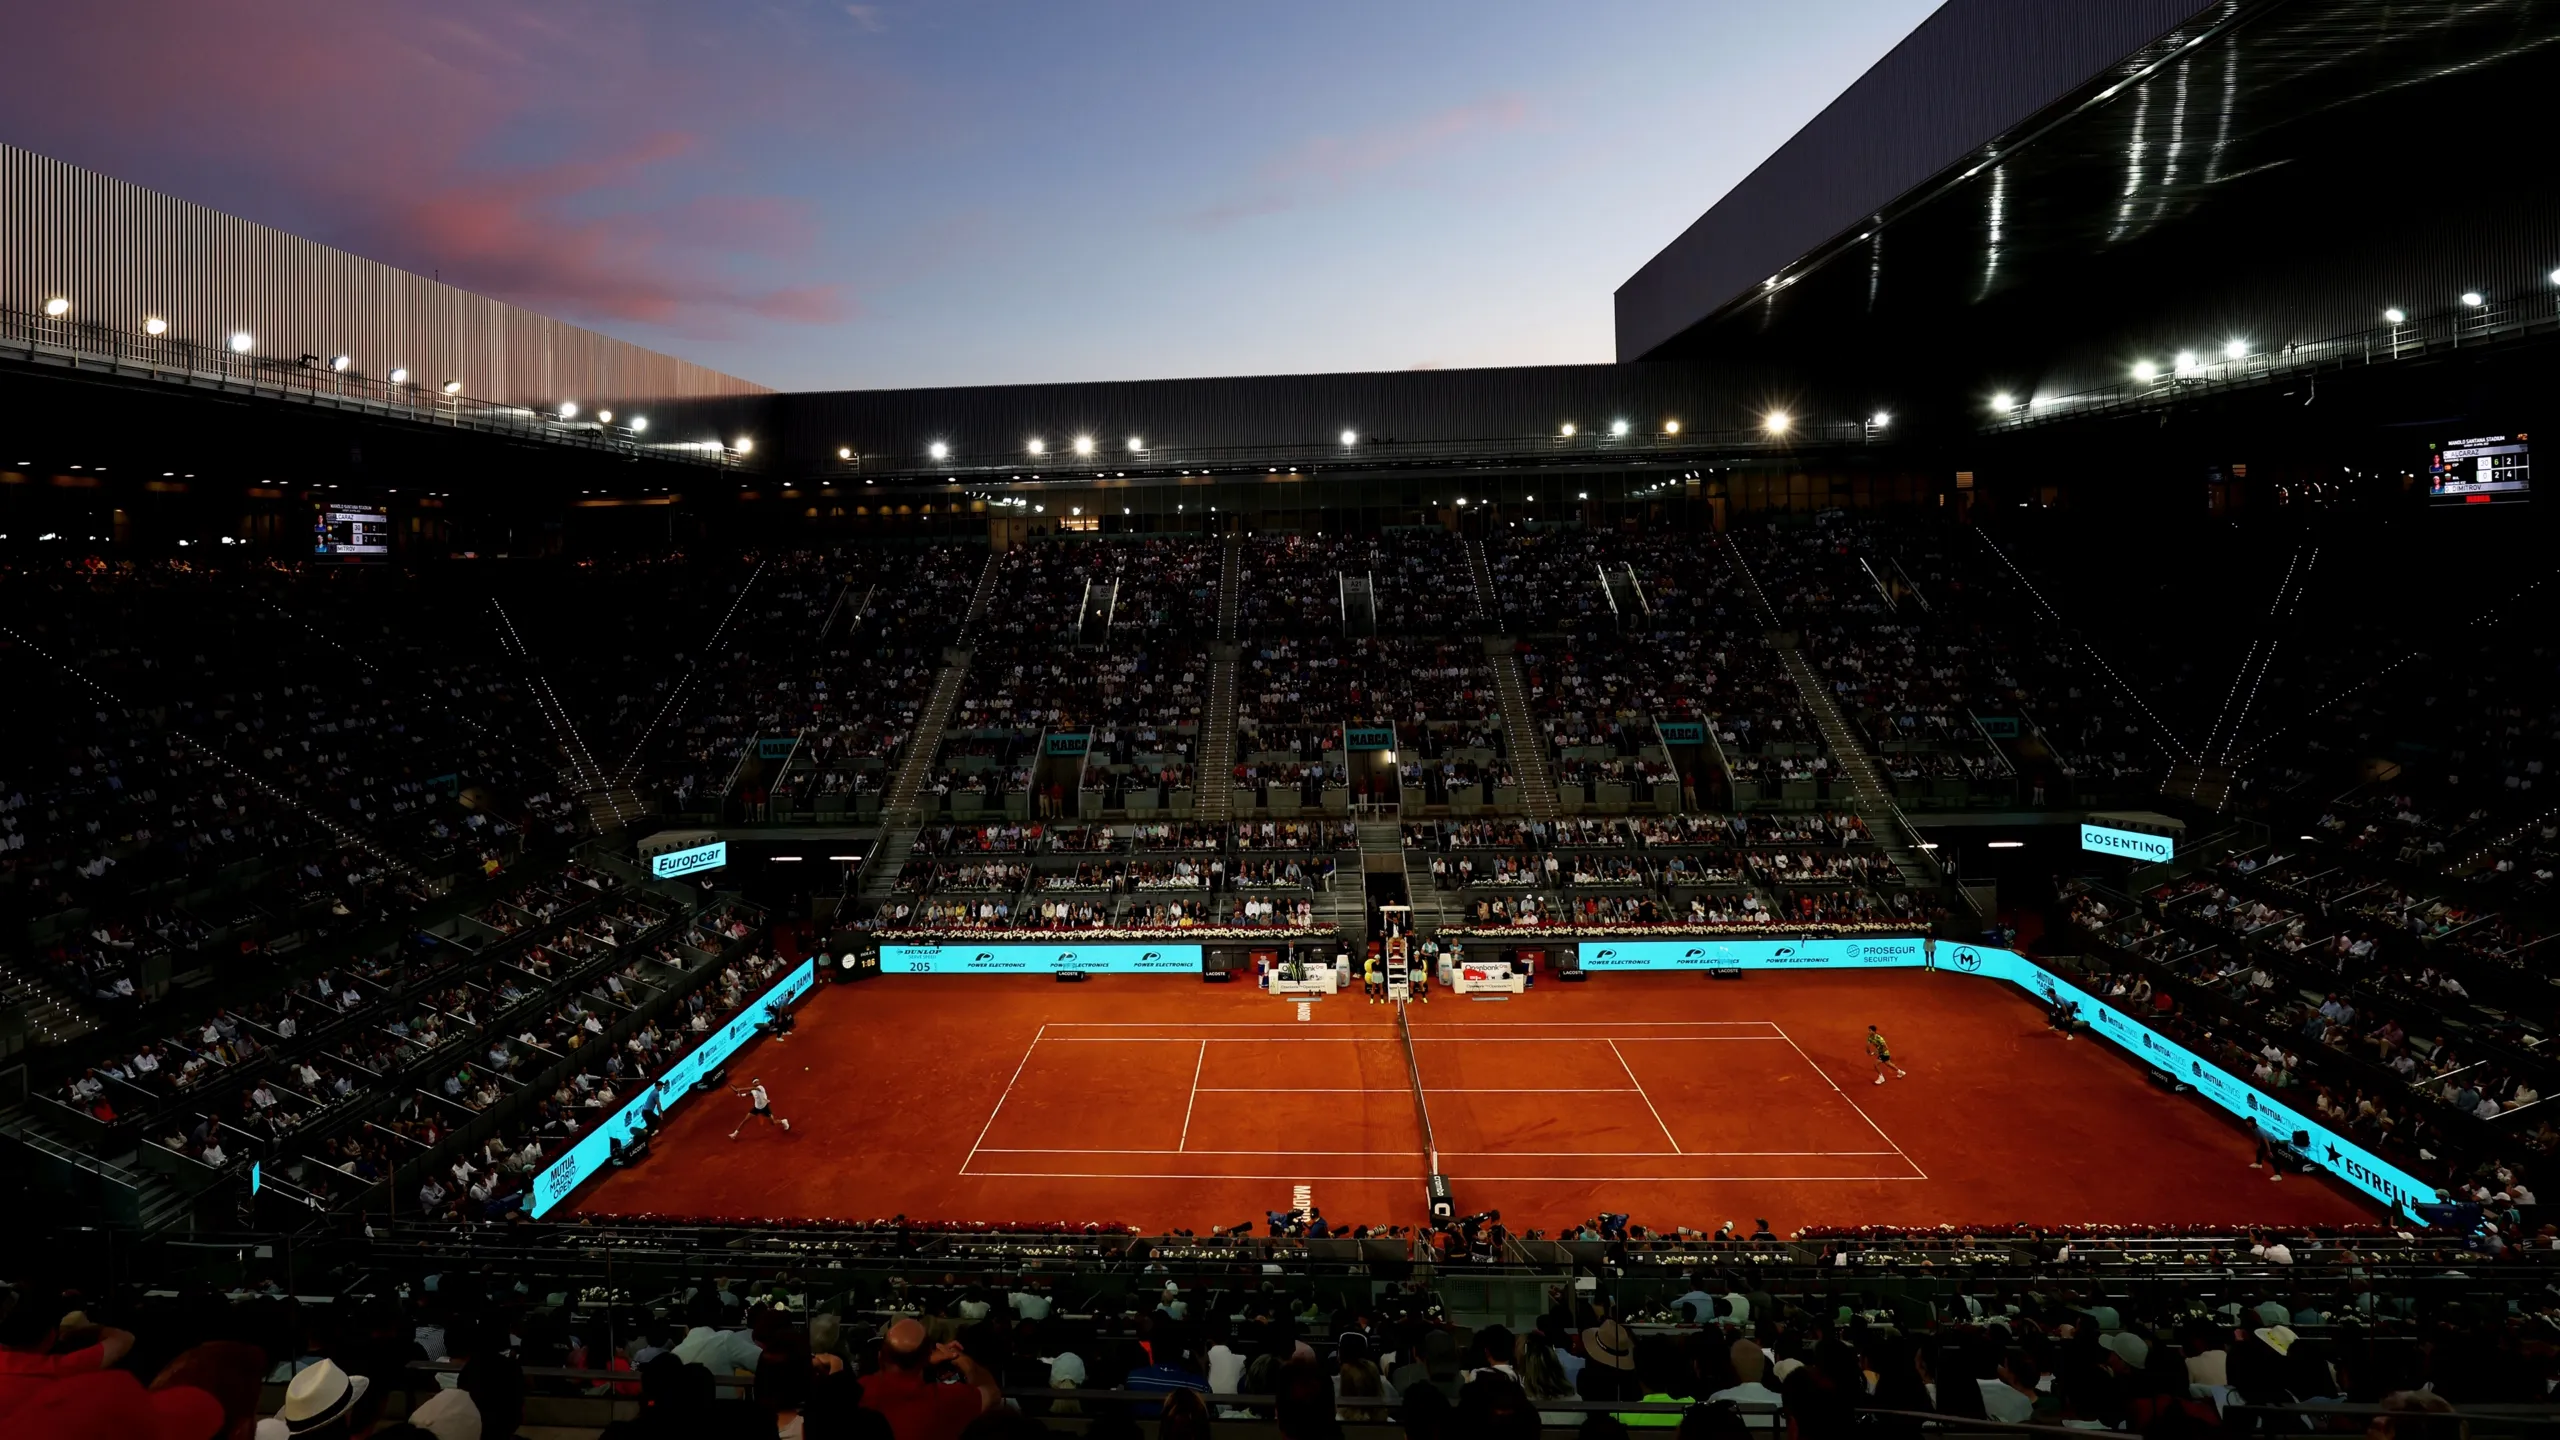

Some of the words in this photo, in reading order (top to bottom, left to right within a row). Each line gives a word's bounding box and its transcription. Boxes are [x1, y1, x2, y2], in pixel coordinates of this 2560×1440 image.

[1350, 734, 1389, 745] MARCA
[1662, 728, 1699, 740] MARCA
[763, 744, 794, 754] MARC
[2085, 833, 2166, 855] COSENTINO
[659, 849, 721, 871] Europcar
[910, 963, 930, 971] 205
[2152, 1069, 2168, 1083] LACOSTE
[630, 1142, 646, 1157] LACOSTE
[550, 1155, 574, 1182] MUTUA
[549, 1166, 576, 1193] MADRID
[1434, 1176, 1444, 1197] crombo
[554, 1179, 573, 1199] OPEN
